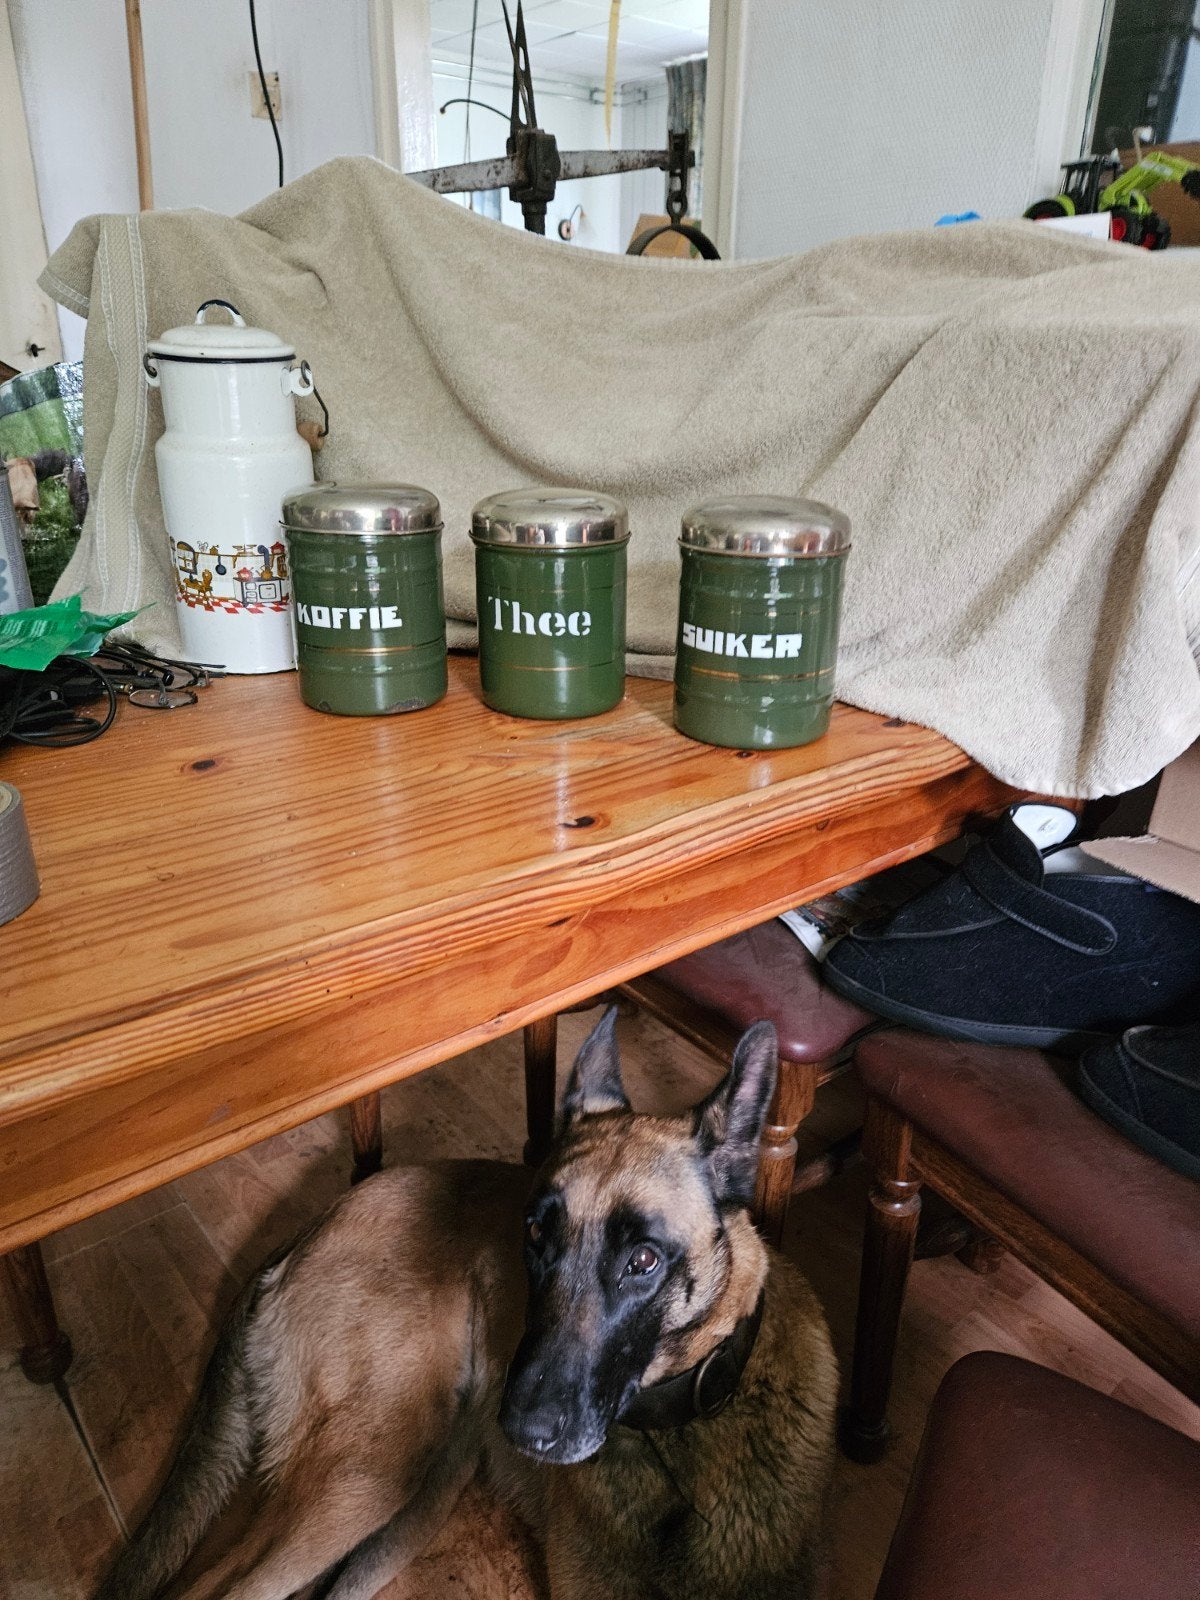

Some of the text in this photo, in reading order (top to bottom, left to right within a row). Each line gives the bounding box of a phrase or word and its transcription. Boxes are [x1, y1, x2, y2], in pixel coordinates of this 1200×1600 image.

[297, 602, 402, 630] KOFFIE
[487, 596, 592, 636] Thee
[682, 621, 803, 659] SUIKER
